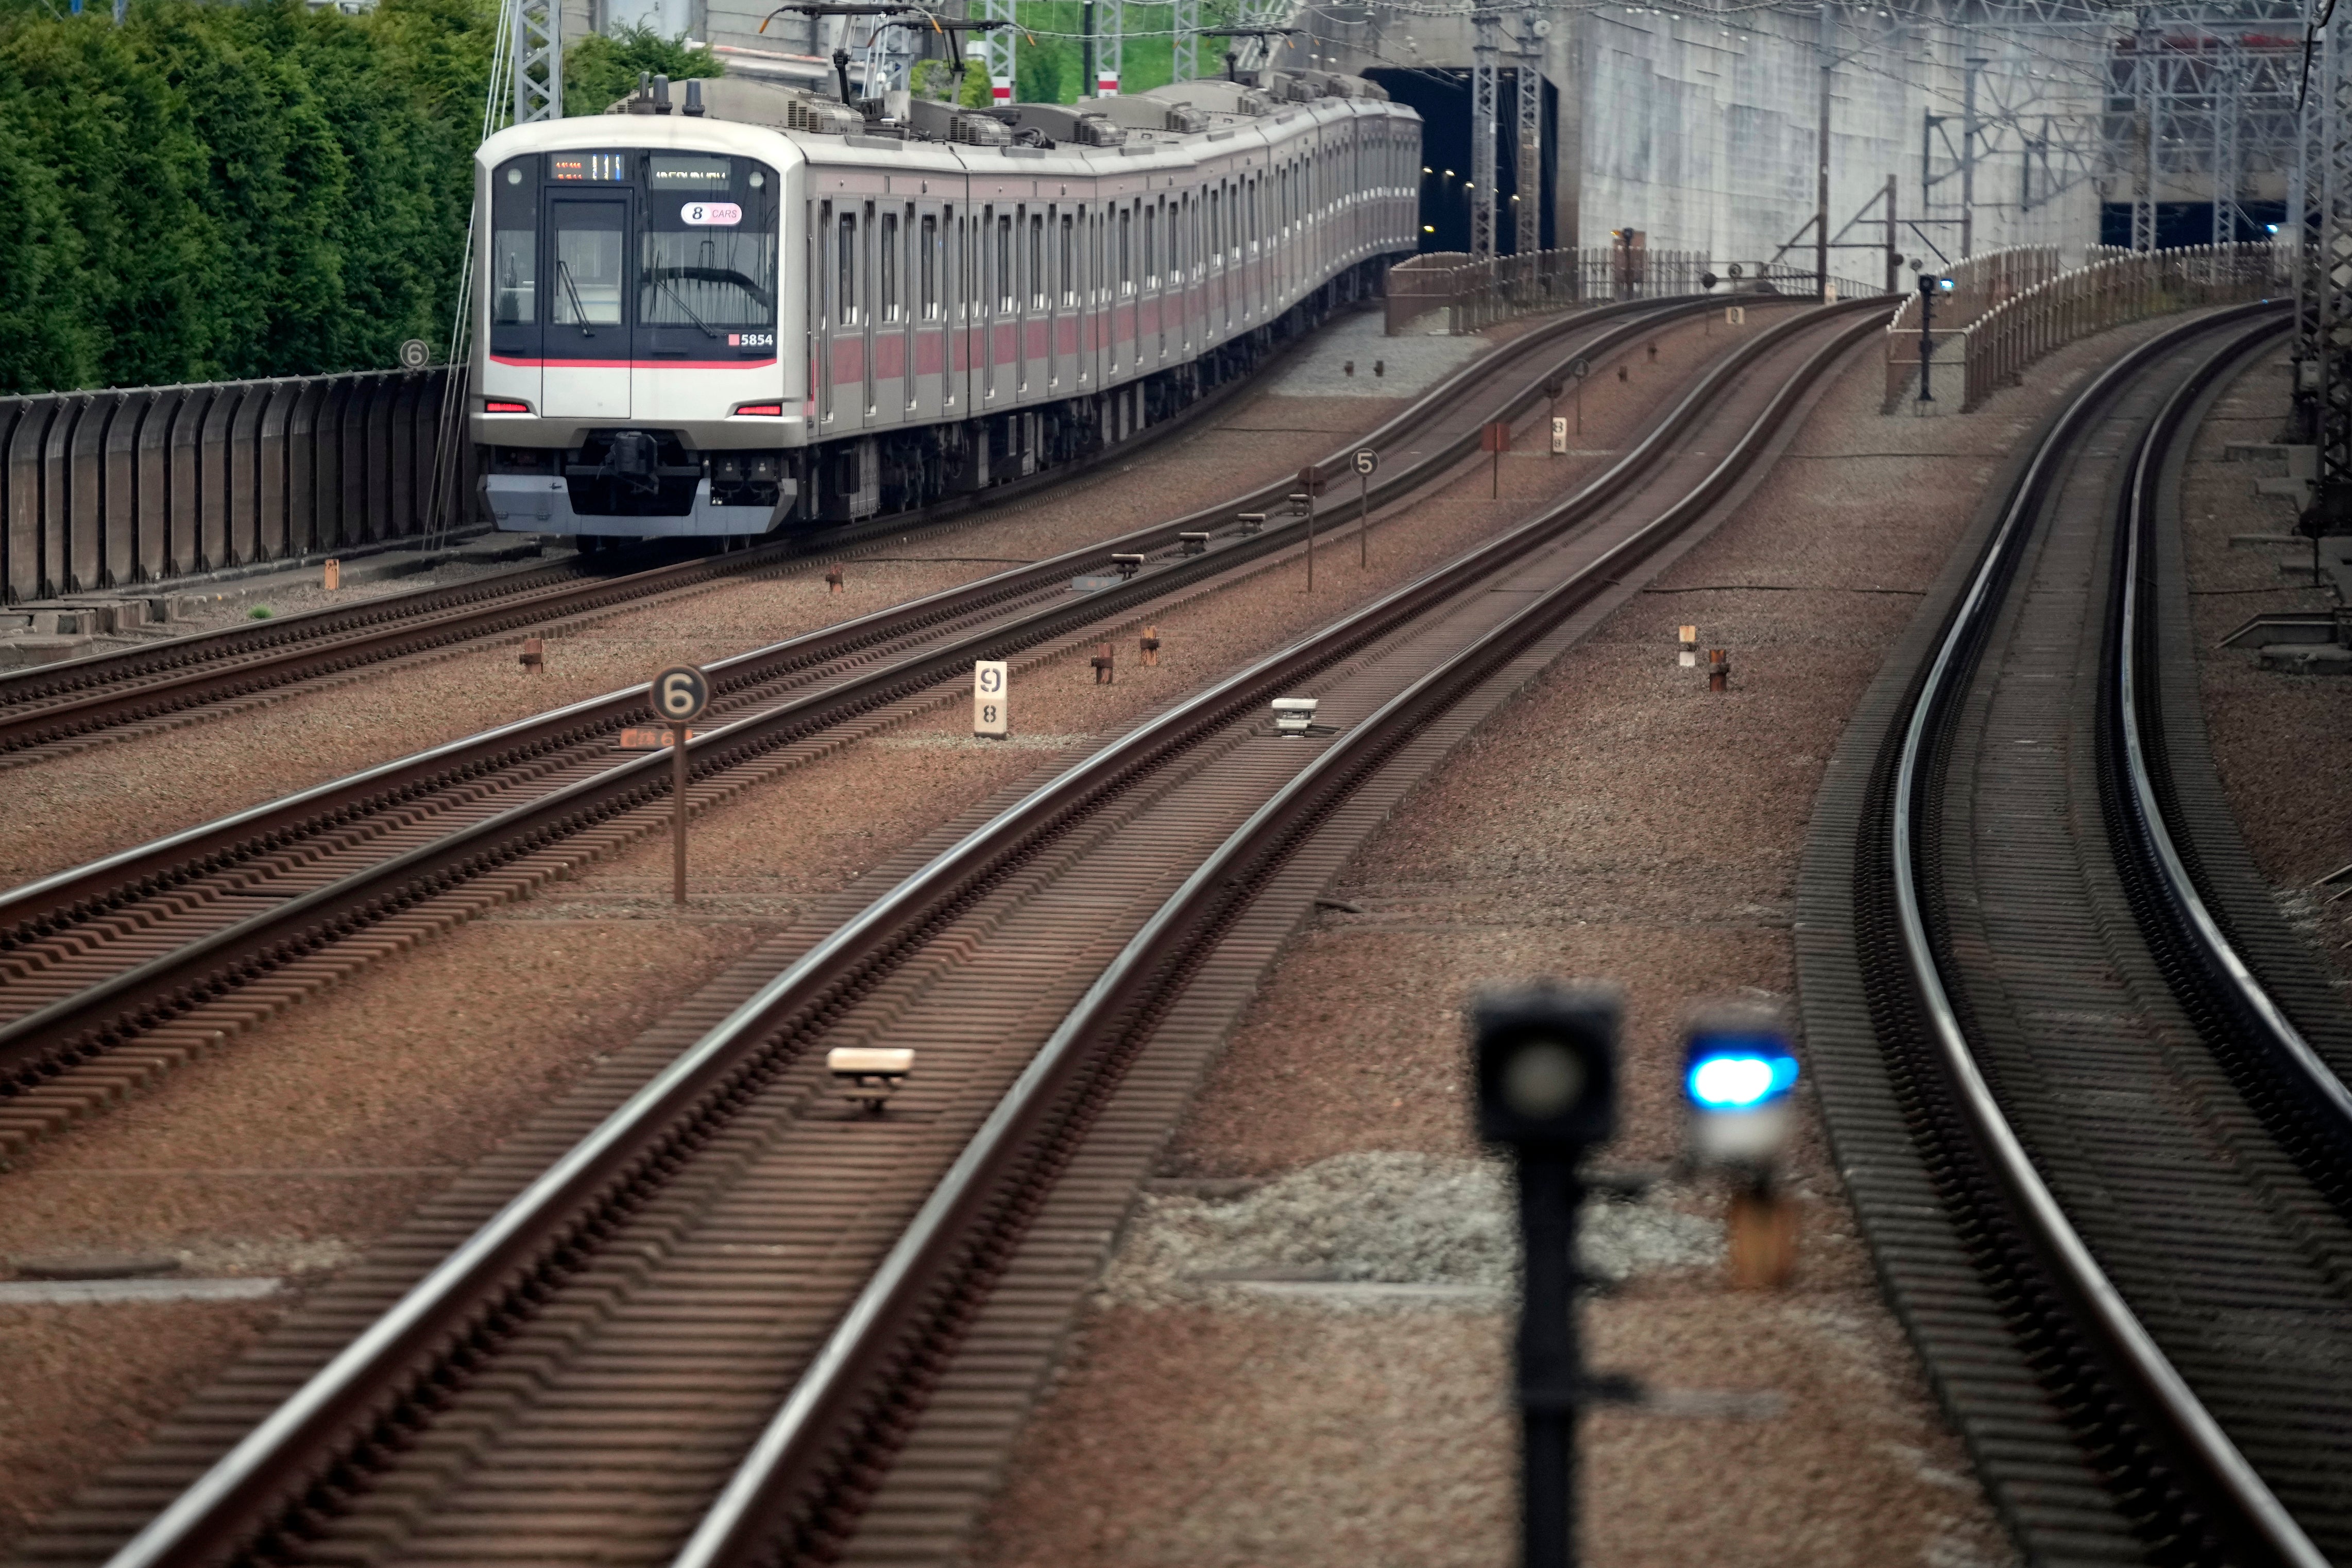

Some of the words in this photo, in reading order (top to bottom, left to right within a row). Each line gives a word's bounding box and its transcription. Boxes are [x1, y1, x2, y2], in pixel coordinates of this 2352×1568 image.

[692, 207, 703, 219] 8
[712, 209, 737, 218] CARS
[741, 334, 773, 346] 5854
[407, 343, 422, 364] 6
[1357, 452, 1373, 473] 5
[980, 668, 1001, 692] 9
[664, 673, 694, 714] 6
[983, 705, 997, 723] 8
